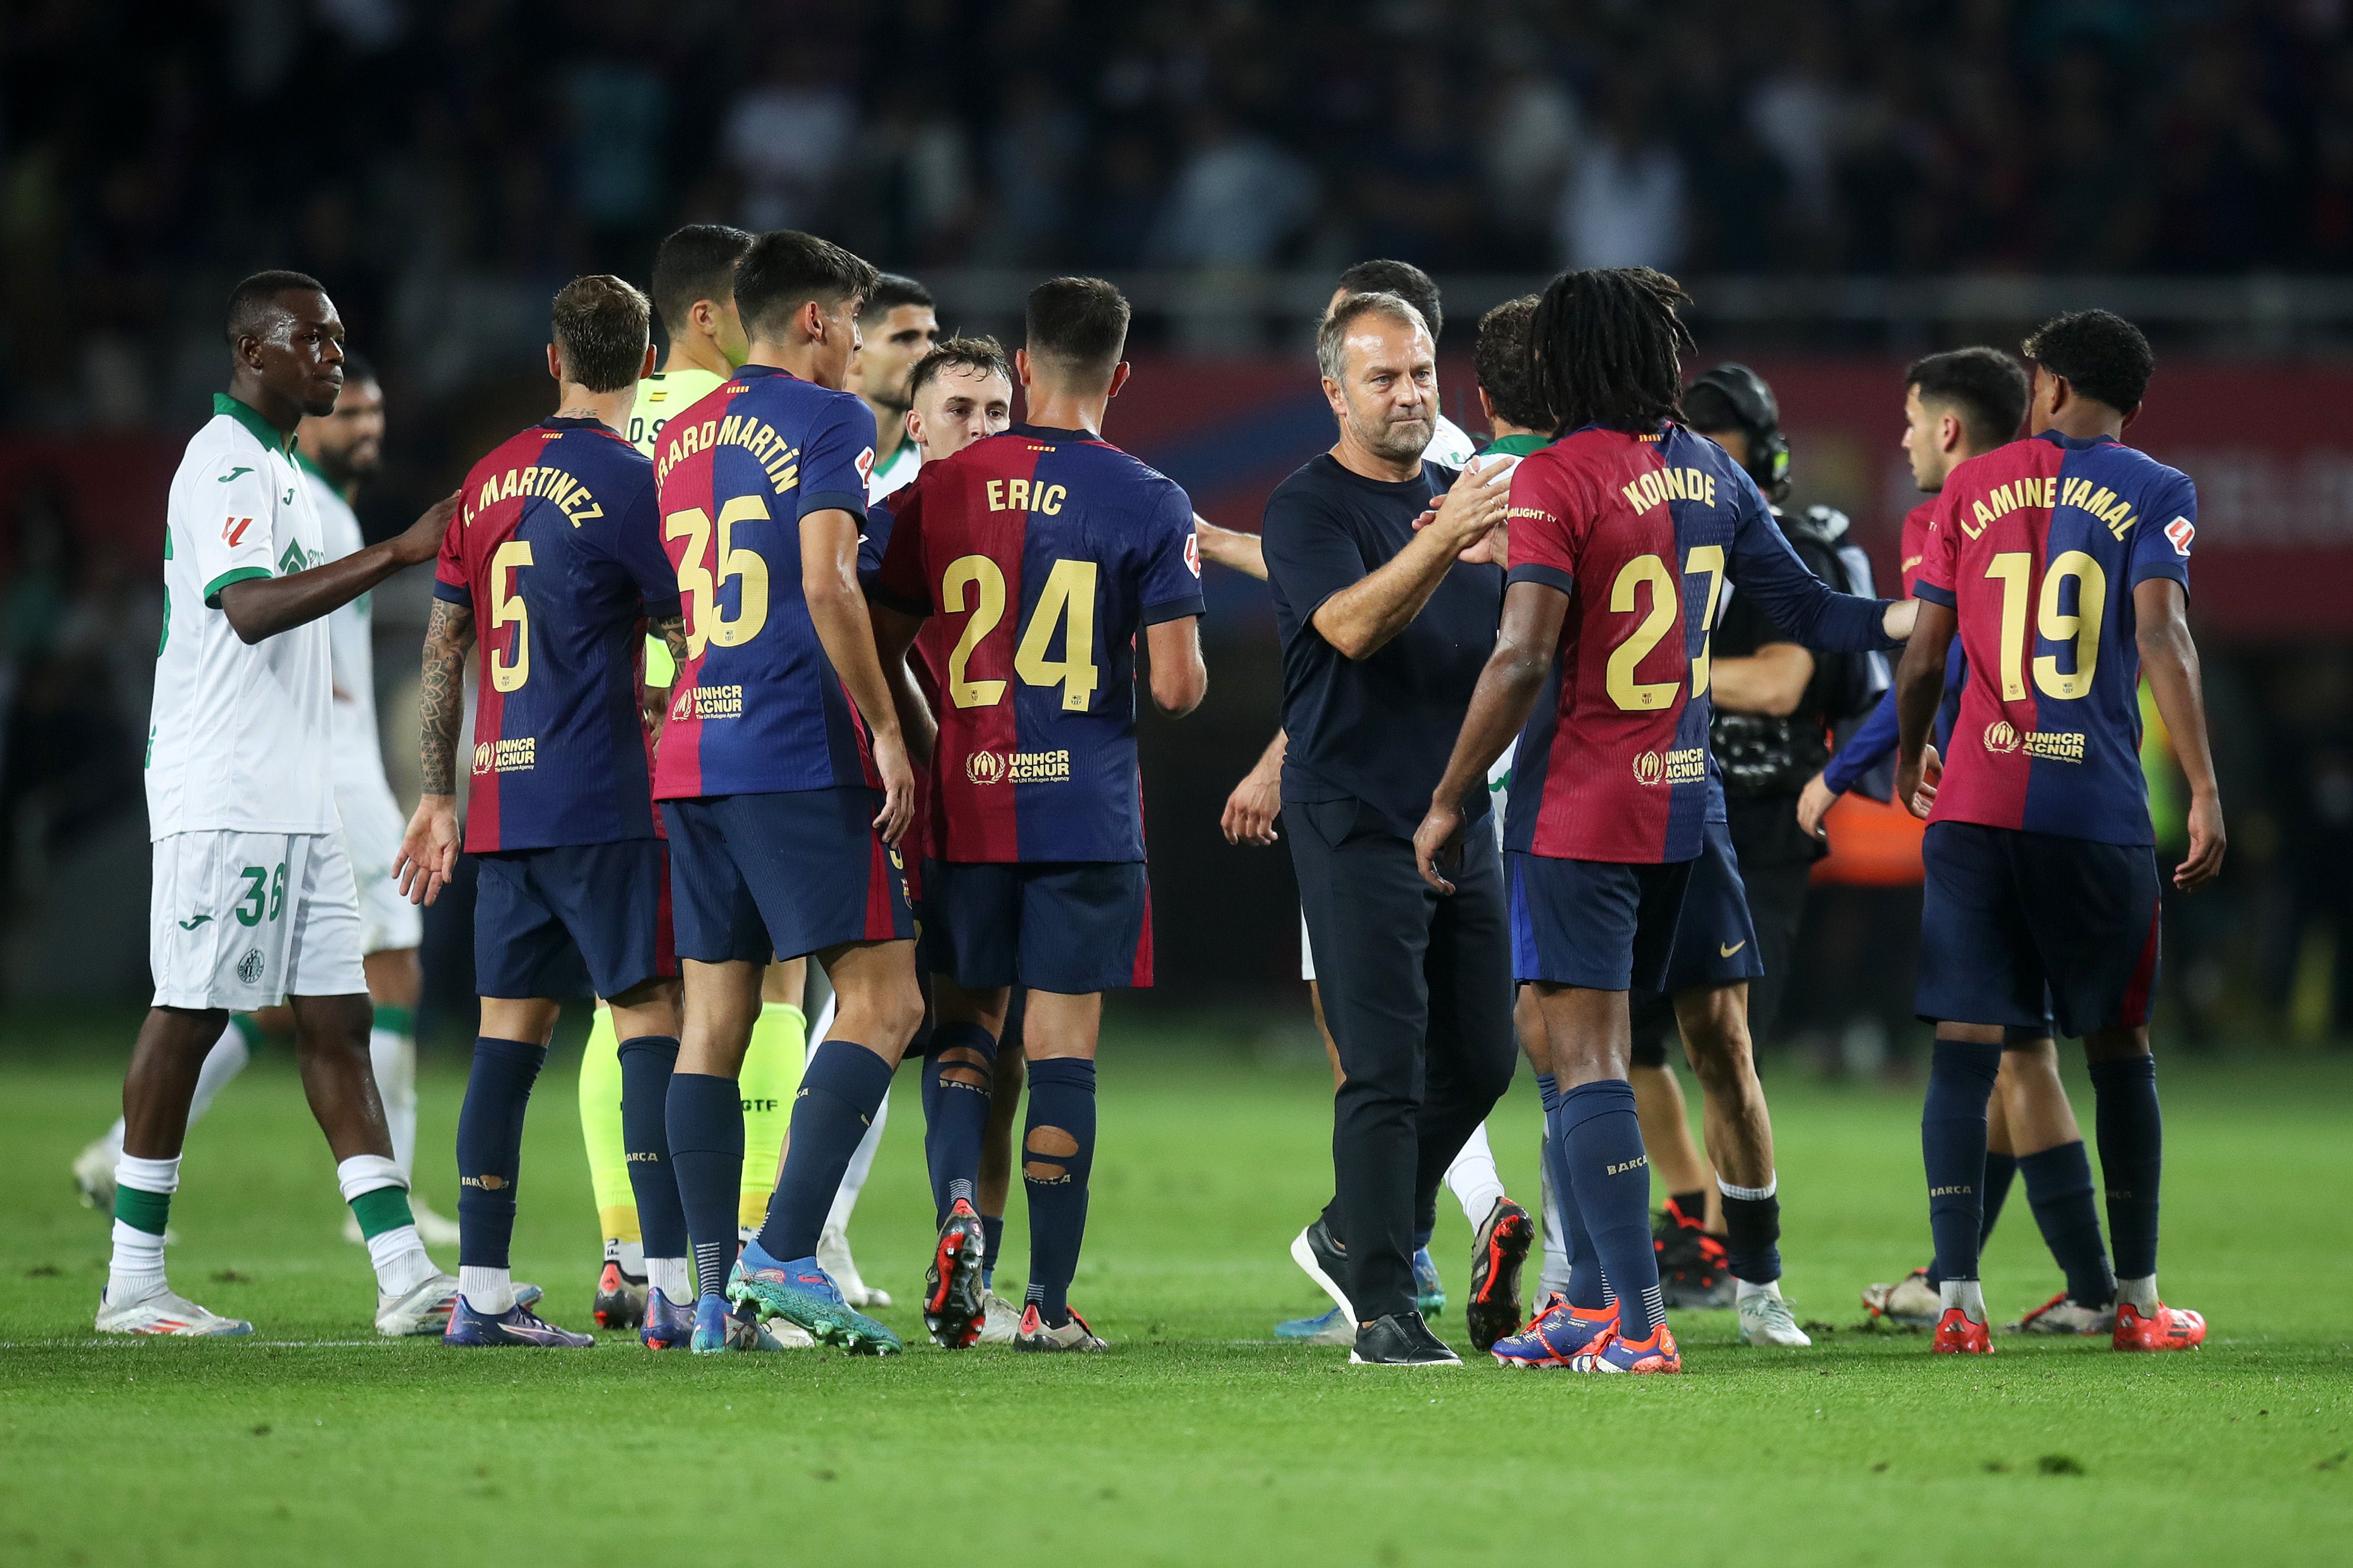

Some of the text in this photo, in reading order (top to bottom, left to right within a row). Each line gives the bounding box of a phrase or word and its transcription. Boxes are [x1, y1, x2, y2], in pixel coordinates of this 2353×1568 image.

[986, 479, 1066, 516] ERIC
[665, 494, 771, 661] 35
[491, 540, 534, 693] 5
[942, 553, 1098, 712] 24
[1605, 544, 1725, 711] 27
[1984, 550, 2107, 702] 19
[692, 684, 743, 700] UNHCR
[695, 699, 742, 714] ACNUR
[496, 737, 535, 754] UNHCR
[2025, 732, 2085, 745] UNHCR
[1008, 749, 1069, 766] UNHCR
[1665, 748, 1704, 765] UNHCR
[2022, 742, 2084, 758] ACNUR
[494, 751, 535, 767] ACNUR
[1007, 762, 1070, 778] ACNUR
[1665, 762, 1705, 778] ACNUR
[236, 862, 285, 927] 36
